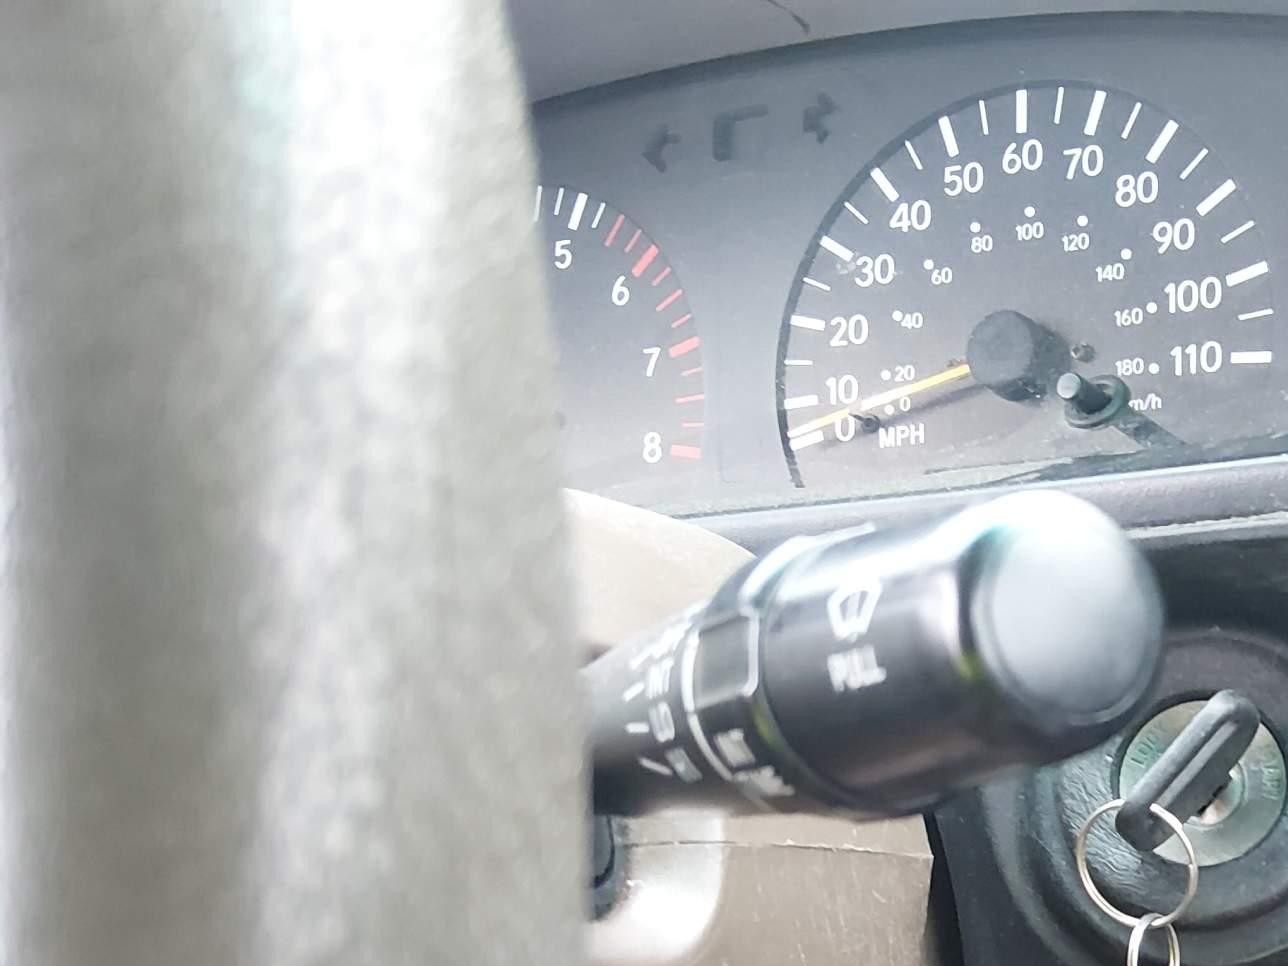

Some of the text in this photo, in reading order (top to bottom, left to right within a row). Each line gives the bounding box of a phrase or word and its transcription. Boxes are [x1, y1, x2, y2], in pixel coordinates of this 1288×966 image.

[1002, 139, 1043, 174] 60
[1063, 144, 1103, 180] 70
[944, 162, 984, 196] 50
[1114, 171, 1159, 208] 80
[890, 200, 931, 232] 40
[970, 235, 993, 253] 80
[1015, 222, 1044, 240] 100
[1061, 233, 1090, 252] 120
[1152, 218, 1195, 254] 90
[554, 240, 573, 269] 5
[855, 254, 895, 287] 30
[931, 267, 952, 285] 60
[1096, 263, 1124, 282] 140
[611, 275, 631, 305] 6
[1164, 276, 1222, 314] 100
[830, 314, 869, 347] 20
[901, 312, 923, 329] 40
[1114, 307, 1143, 327] 160
[643, 347, 661, 376] 7
[894, 364, 915, 381] 20
[1115, 357, 1144, 377] 180
[1170, 340, 1222, 376] 110
[826, 374, 859, 405] 10
[1128, 393, 1162, 410] m/h
[900, 397, 911, 412] 0
[834, 410, 856, 442] 0
[879, 423, 925, 448] MPH
[642, 431, 662, 463] 8
